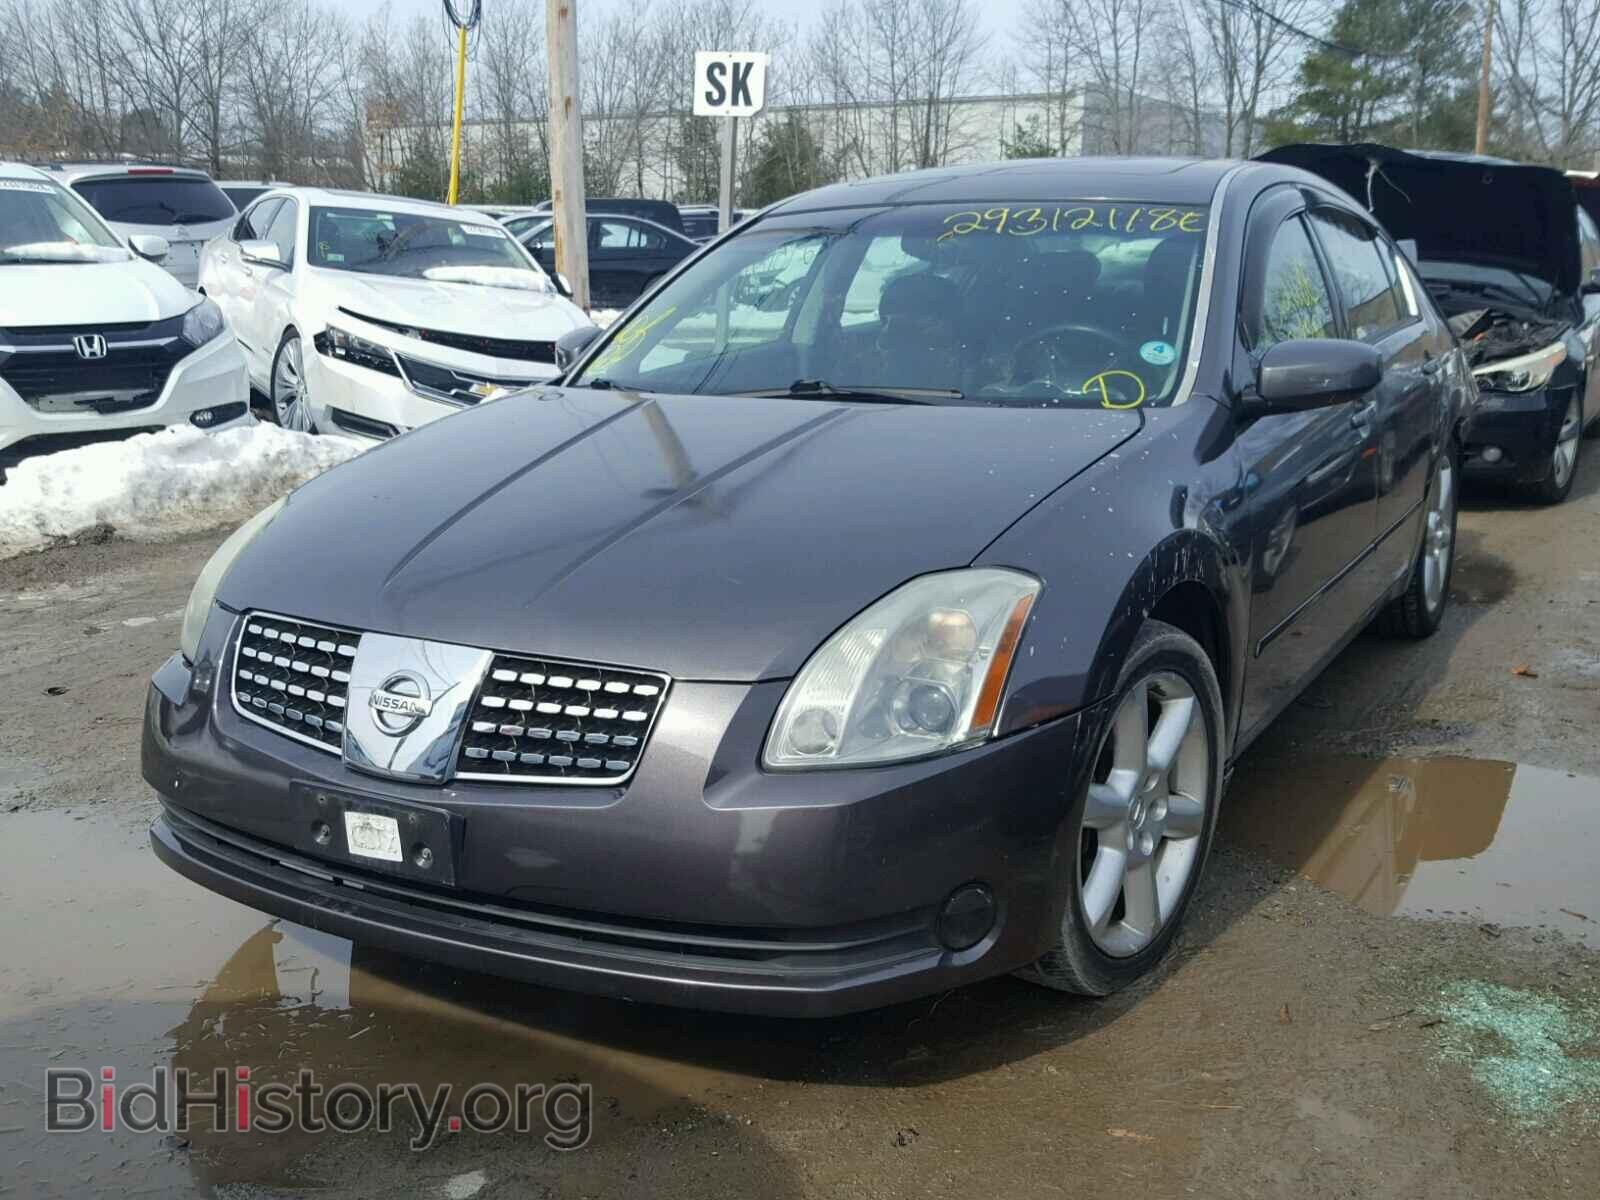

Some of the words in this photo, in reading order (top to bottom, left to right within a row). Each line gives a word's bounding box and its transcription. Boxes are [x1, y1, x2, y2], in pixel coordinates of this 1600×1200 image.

[705, 61, 754, 107] SK
[1082, 370, 1145, 409] D
[371, 694, 416, 713] NISSAN
